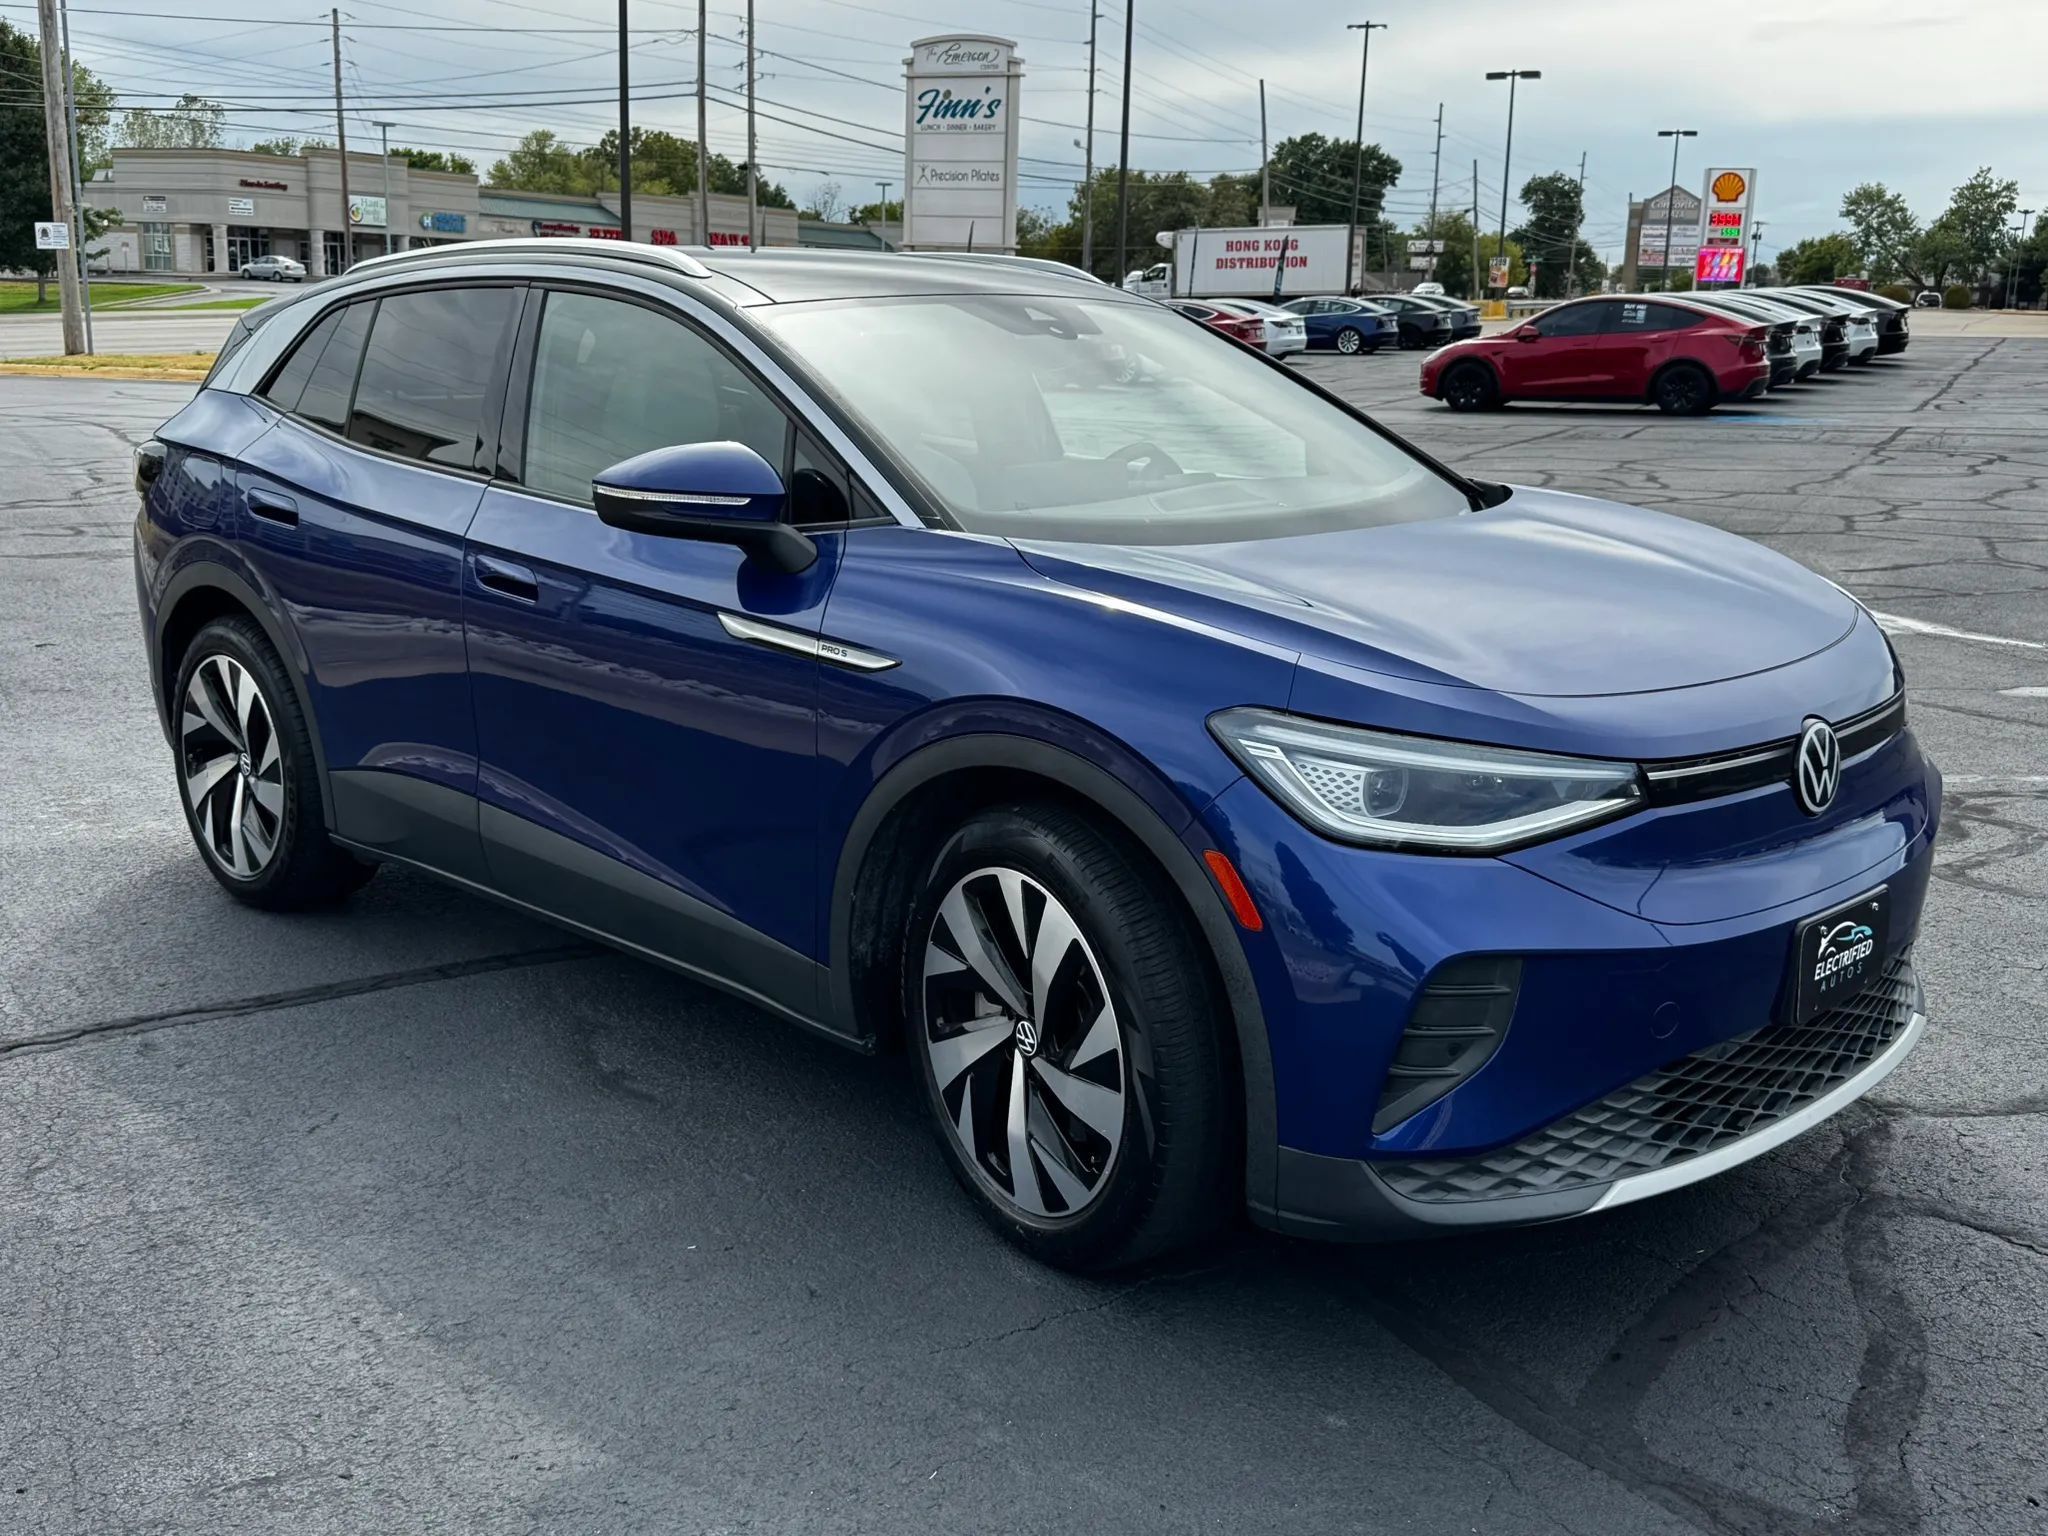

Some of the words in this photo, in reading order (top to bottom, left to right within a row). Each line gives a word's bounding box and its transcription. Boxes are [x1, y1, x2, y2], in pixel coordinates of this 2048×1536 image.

[926, 47, 937, 61] The
[937, 42, 999, 65] Emerson
[916, 86, 1001, 124] Finn's
[930, 169, 968, 182] Precision
[971, 169, 1000, 182] Pilates
[651, 229, 677, 245] SPA
[1226, 240, 1260, 252] HONG
[1264, 239, 1299, 251] KOG
[821, 644, 841, 655] PRO
[841, 649, 848, 657] S
[1814, 939, 1873, 981] ELECTRIFIED
[1820, 962, 1863, 992] AUTOS
